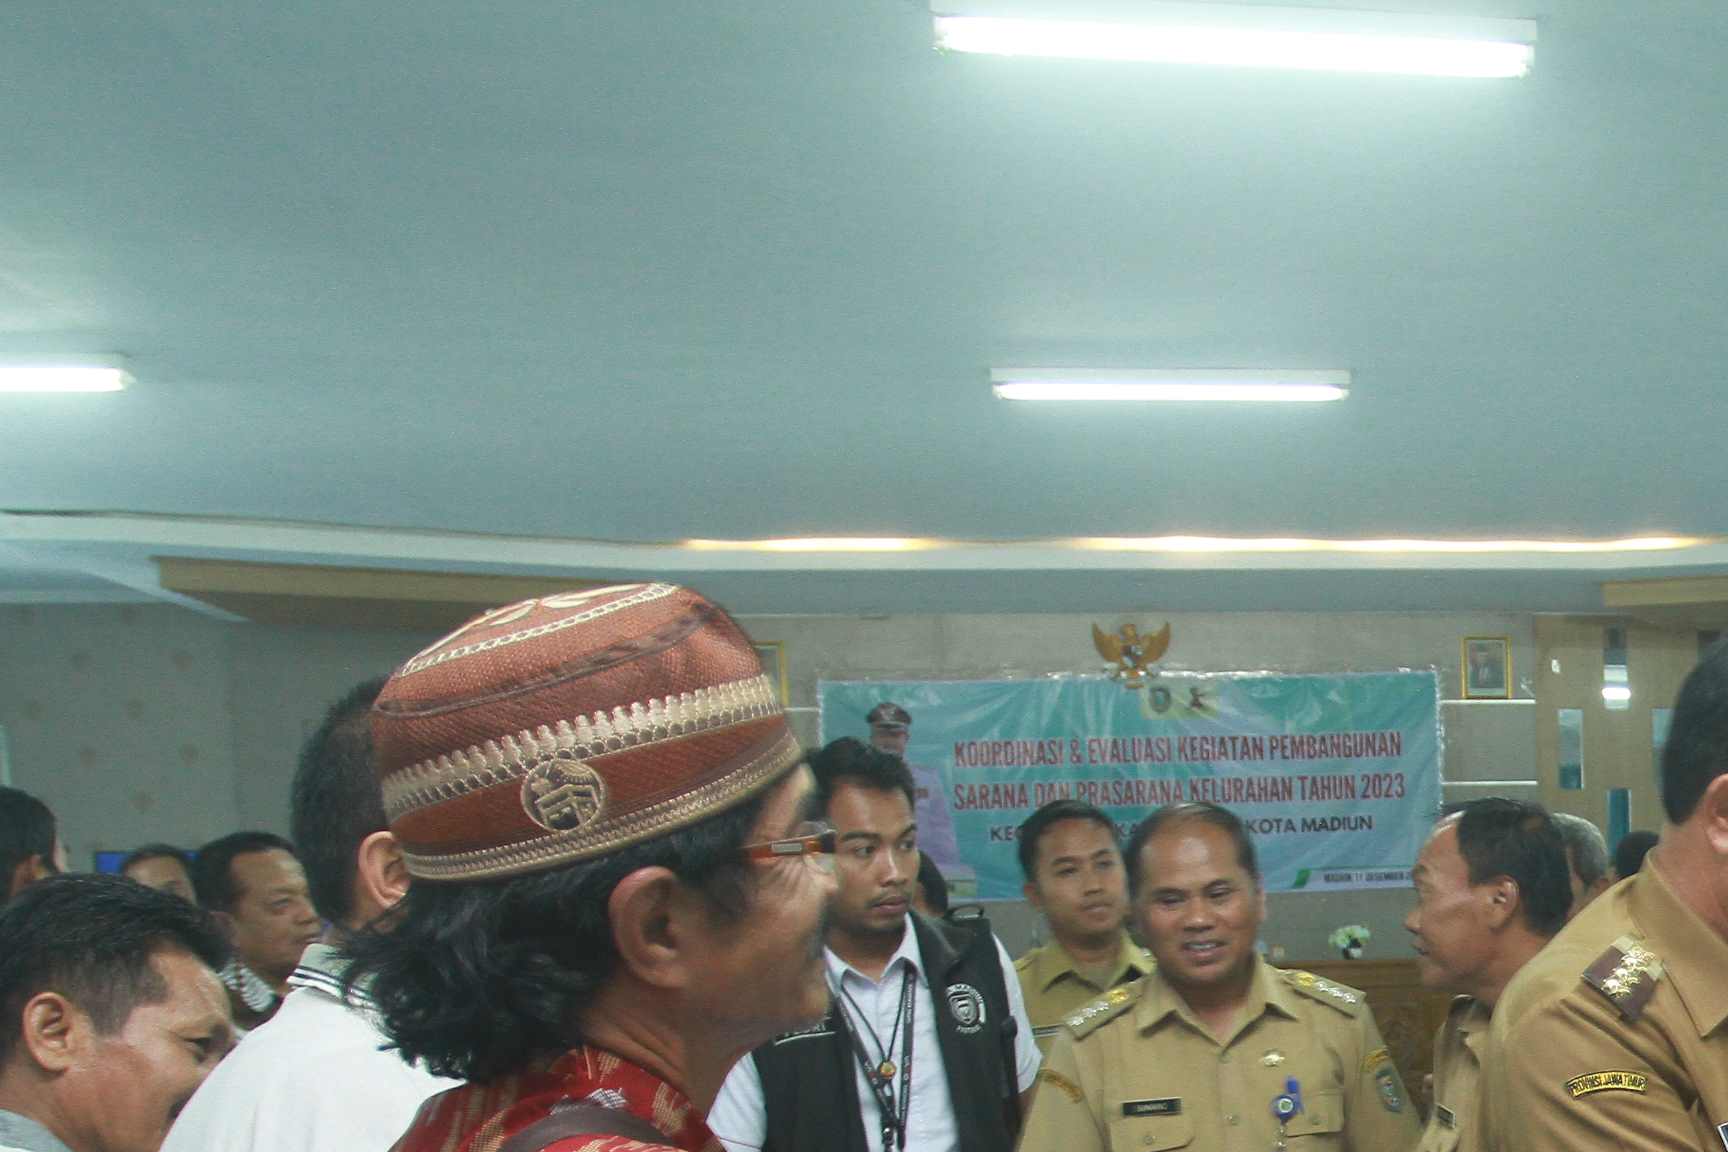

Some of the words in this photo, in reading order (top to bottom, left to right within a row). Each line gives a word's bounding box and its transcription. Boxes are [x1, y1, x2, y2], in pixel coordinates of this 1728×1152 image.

[954, 739, 1063, 767] KOORDINASI
[1069, 739, 1082, 765] &
[1087, 737, 1172, 765] EVALUASI
[1178, 735, 1264, 762] KEGIATAN
[1269, 731, 1401, 760] PEMBANGUNAN
[954, 783, 1028, 810] SARANA
[1077, 779, 1184, 807] PRASARANA
[1189, 776, 1293, 803] KELURAHAN
[1297, 774, 1356, 801] TAHUN
[1360, 772, 1405, 799] 2023
[1248, 818, 1297, 834] KOTA
[1301, 815, 1373, 833] MADIUN
